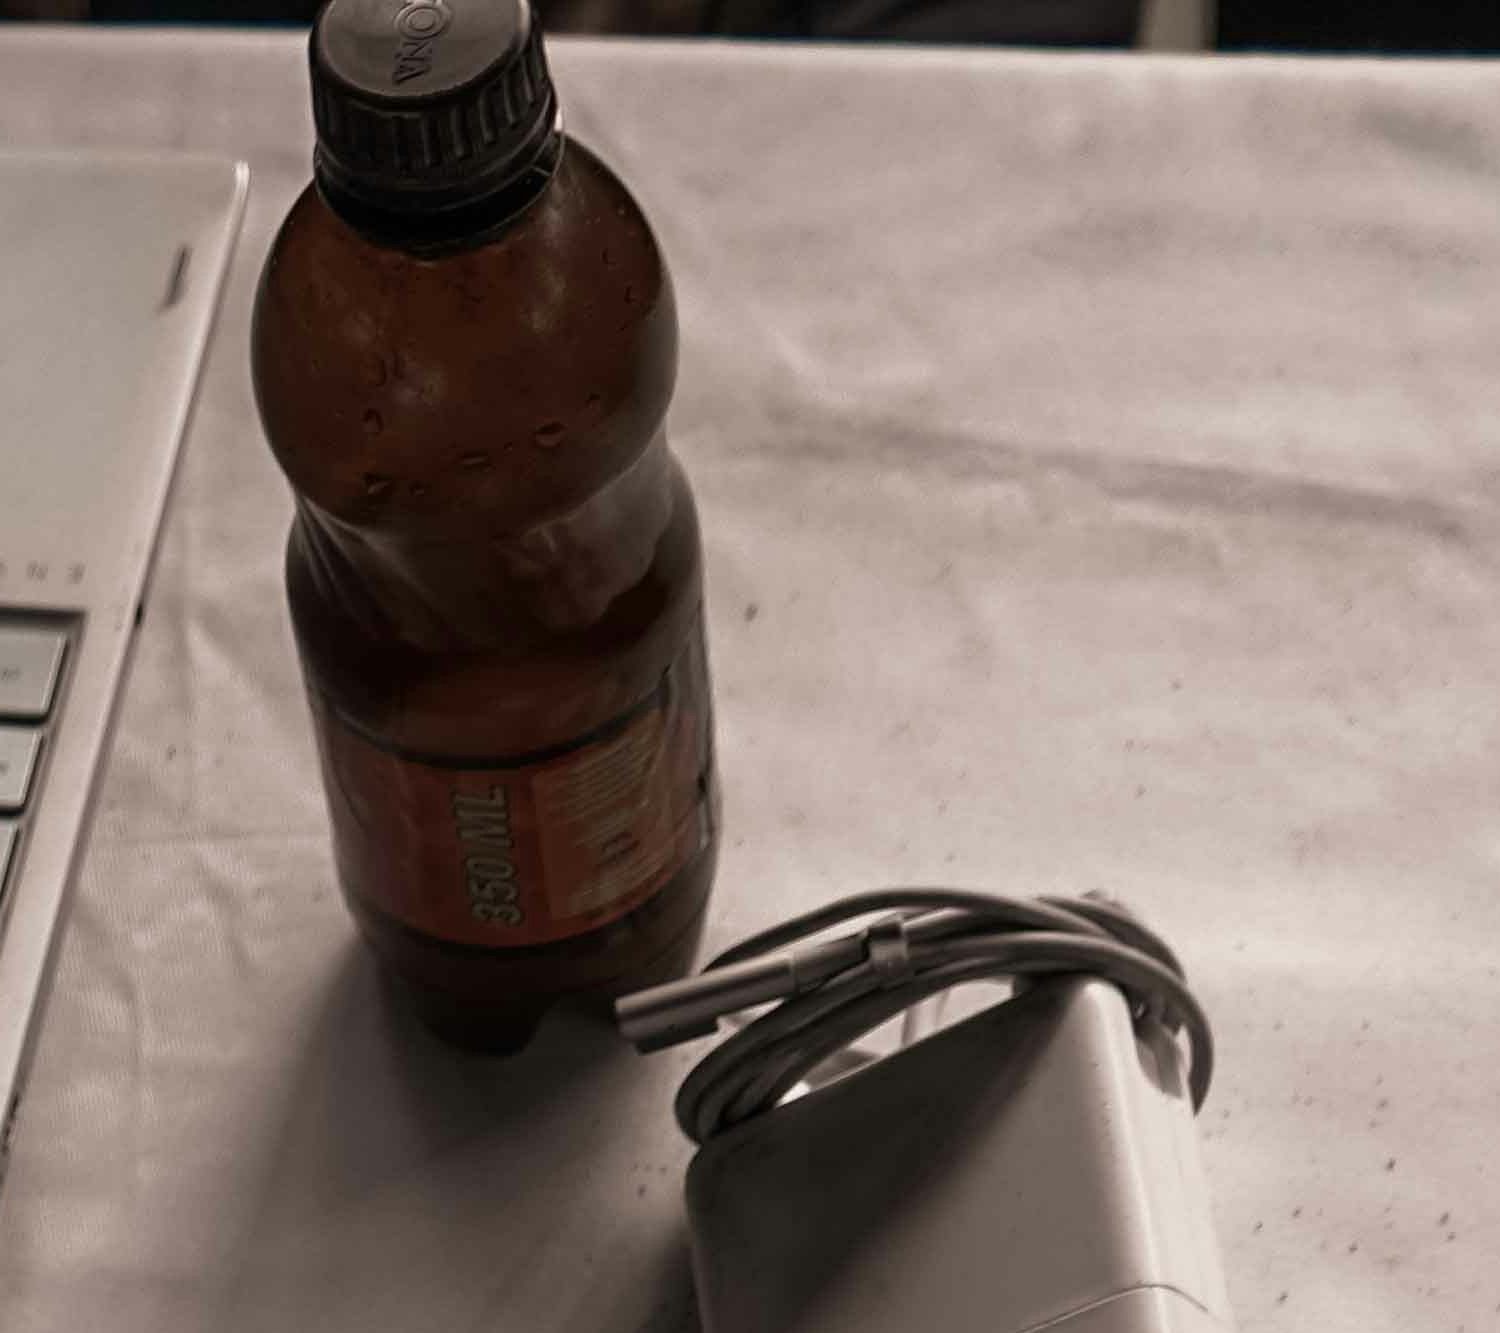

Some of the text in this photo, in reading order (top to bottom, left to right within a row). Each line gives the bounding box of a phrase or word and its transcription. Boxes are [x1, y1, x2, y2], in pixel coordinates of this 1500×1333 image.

[393, 0, 455, 85] ONA
[450, 785, 522, 926] 350 ML
